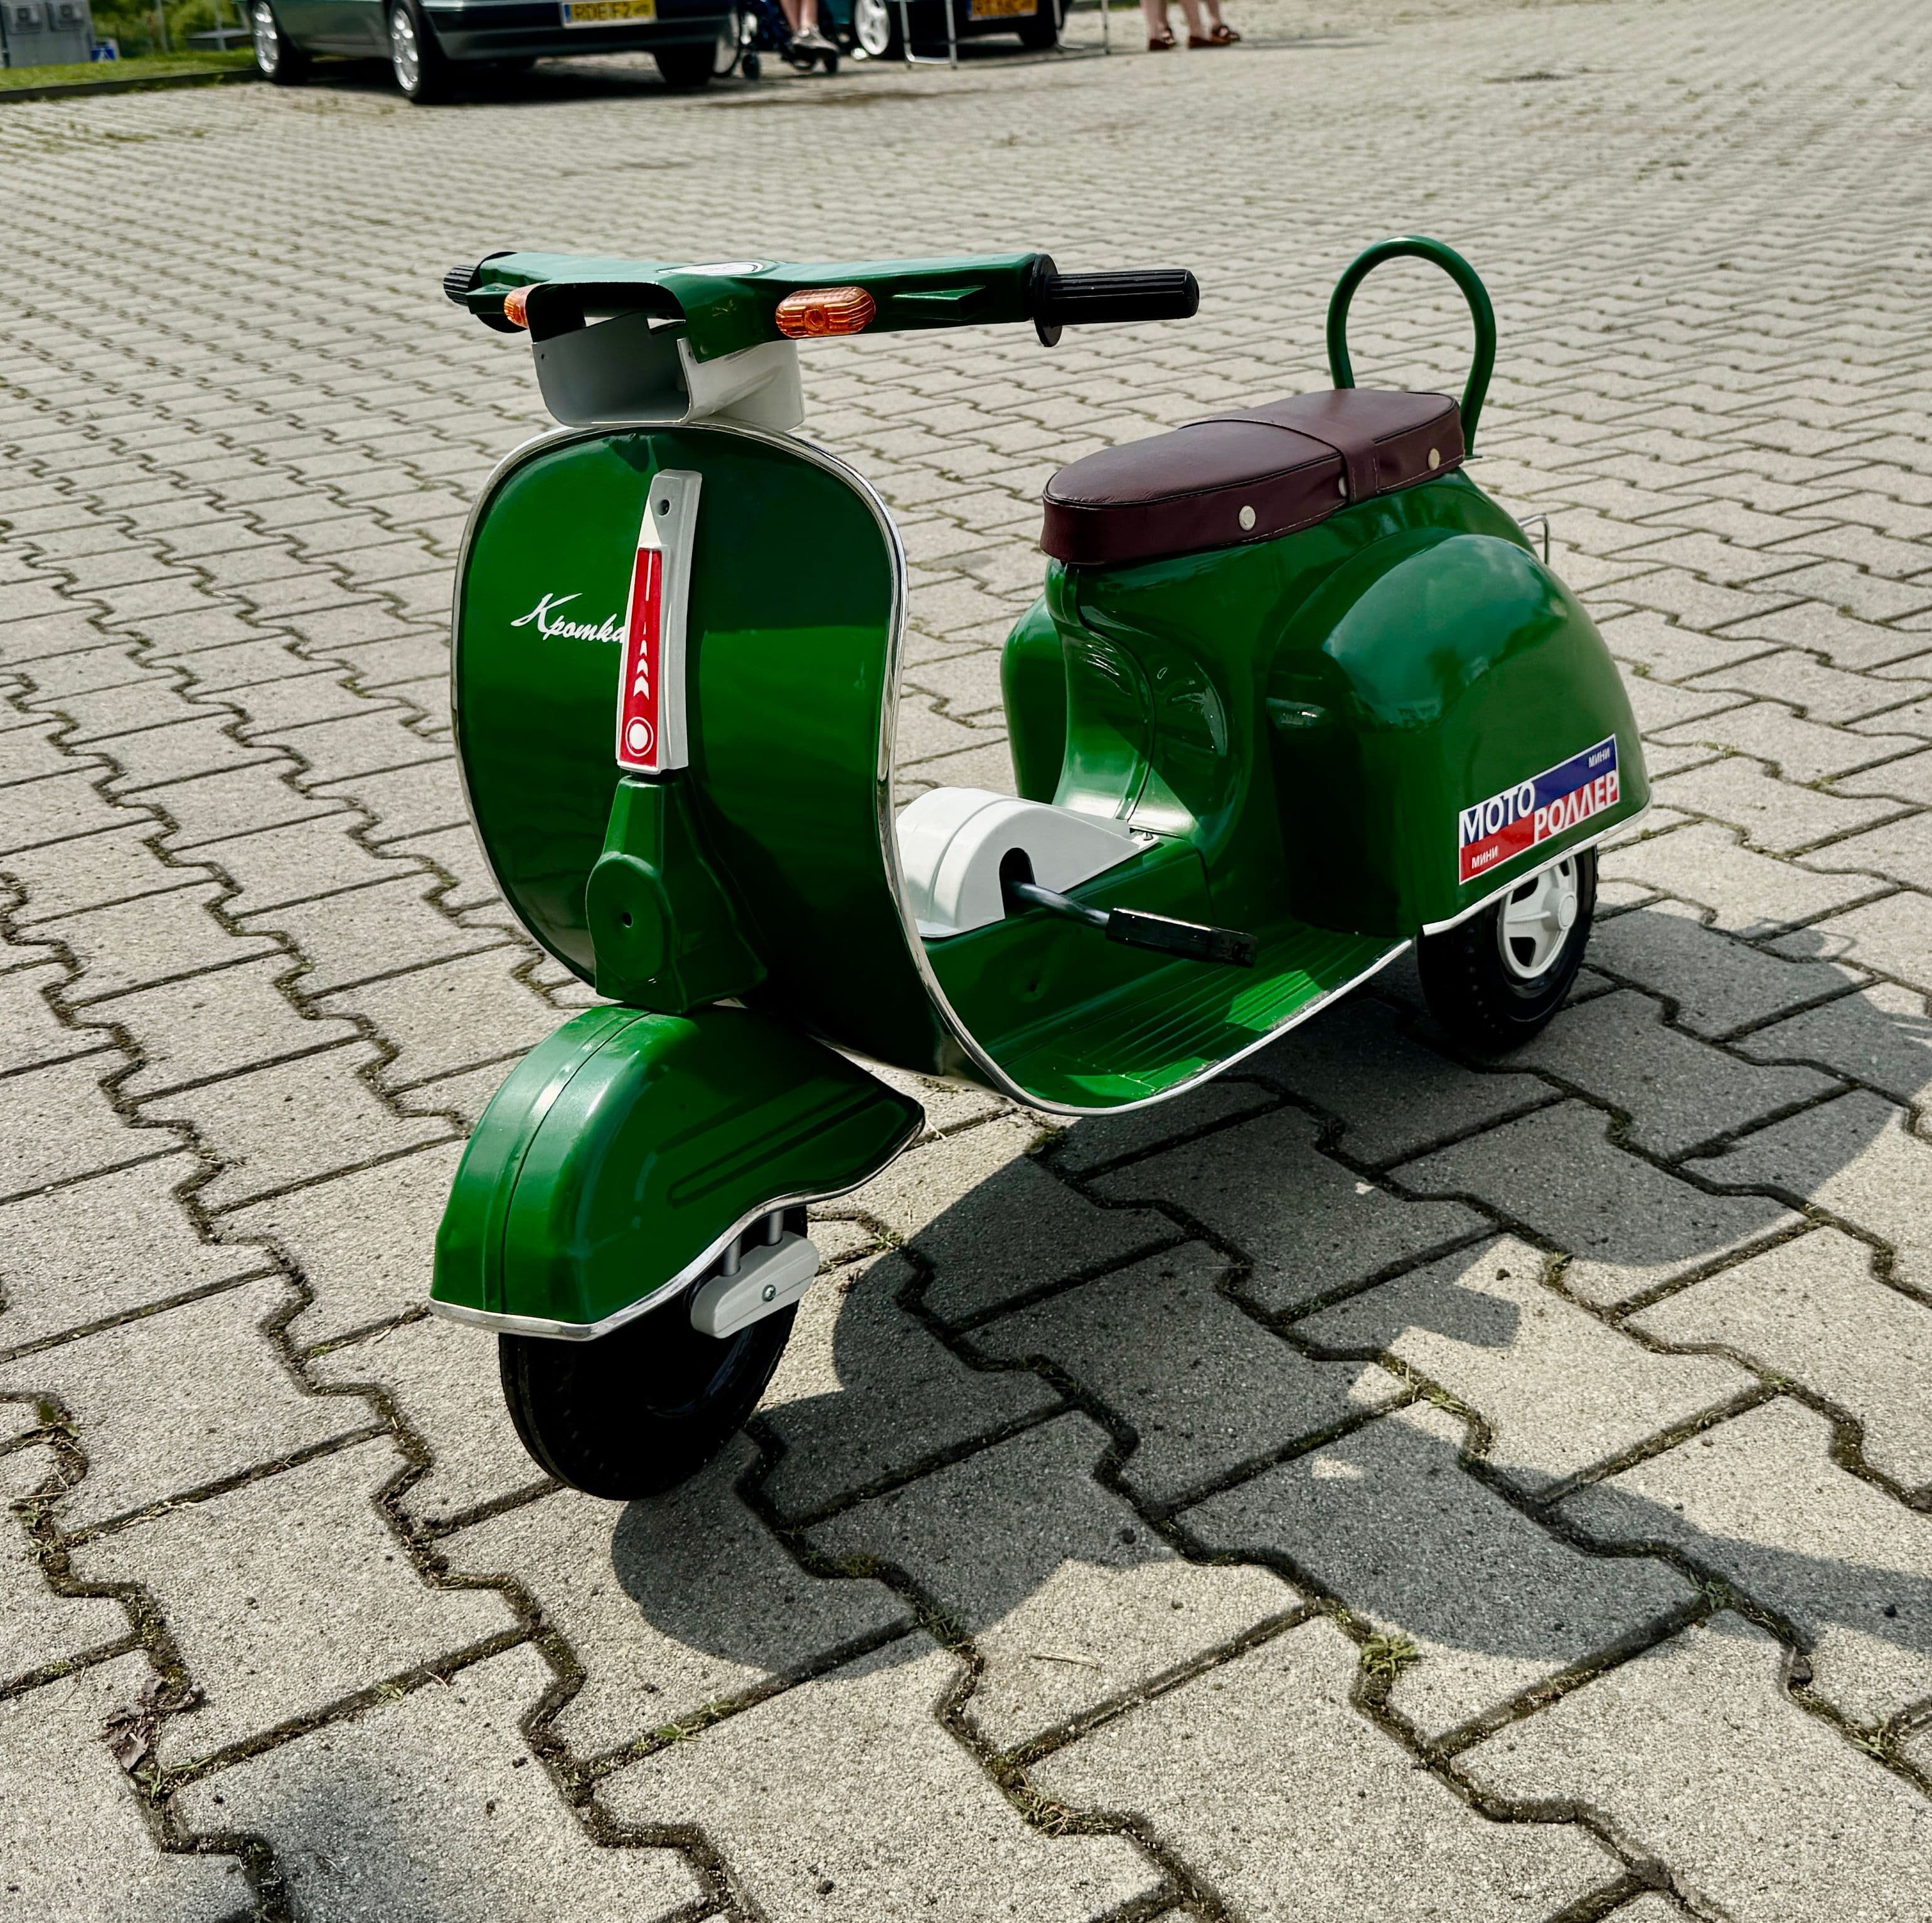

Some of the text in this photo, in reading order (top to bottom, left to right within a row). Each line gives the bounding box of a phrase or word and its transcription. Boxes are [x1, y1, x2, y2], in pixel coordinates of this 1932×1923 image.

[1588, 747, 1611, 768] МИНИ
[1460, 770, 1620, 848] МОТО РОЛЛЕР
[1471, 845, 1498, 869] МИНИ
